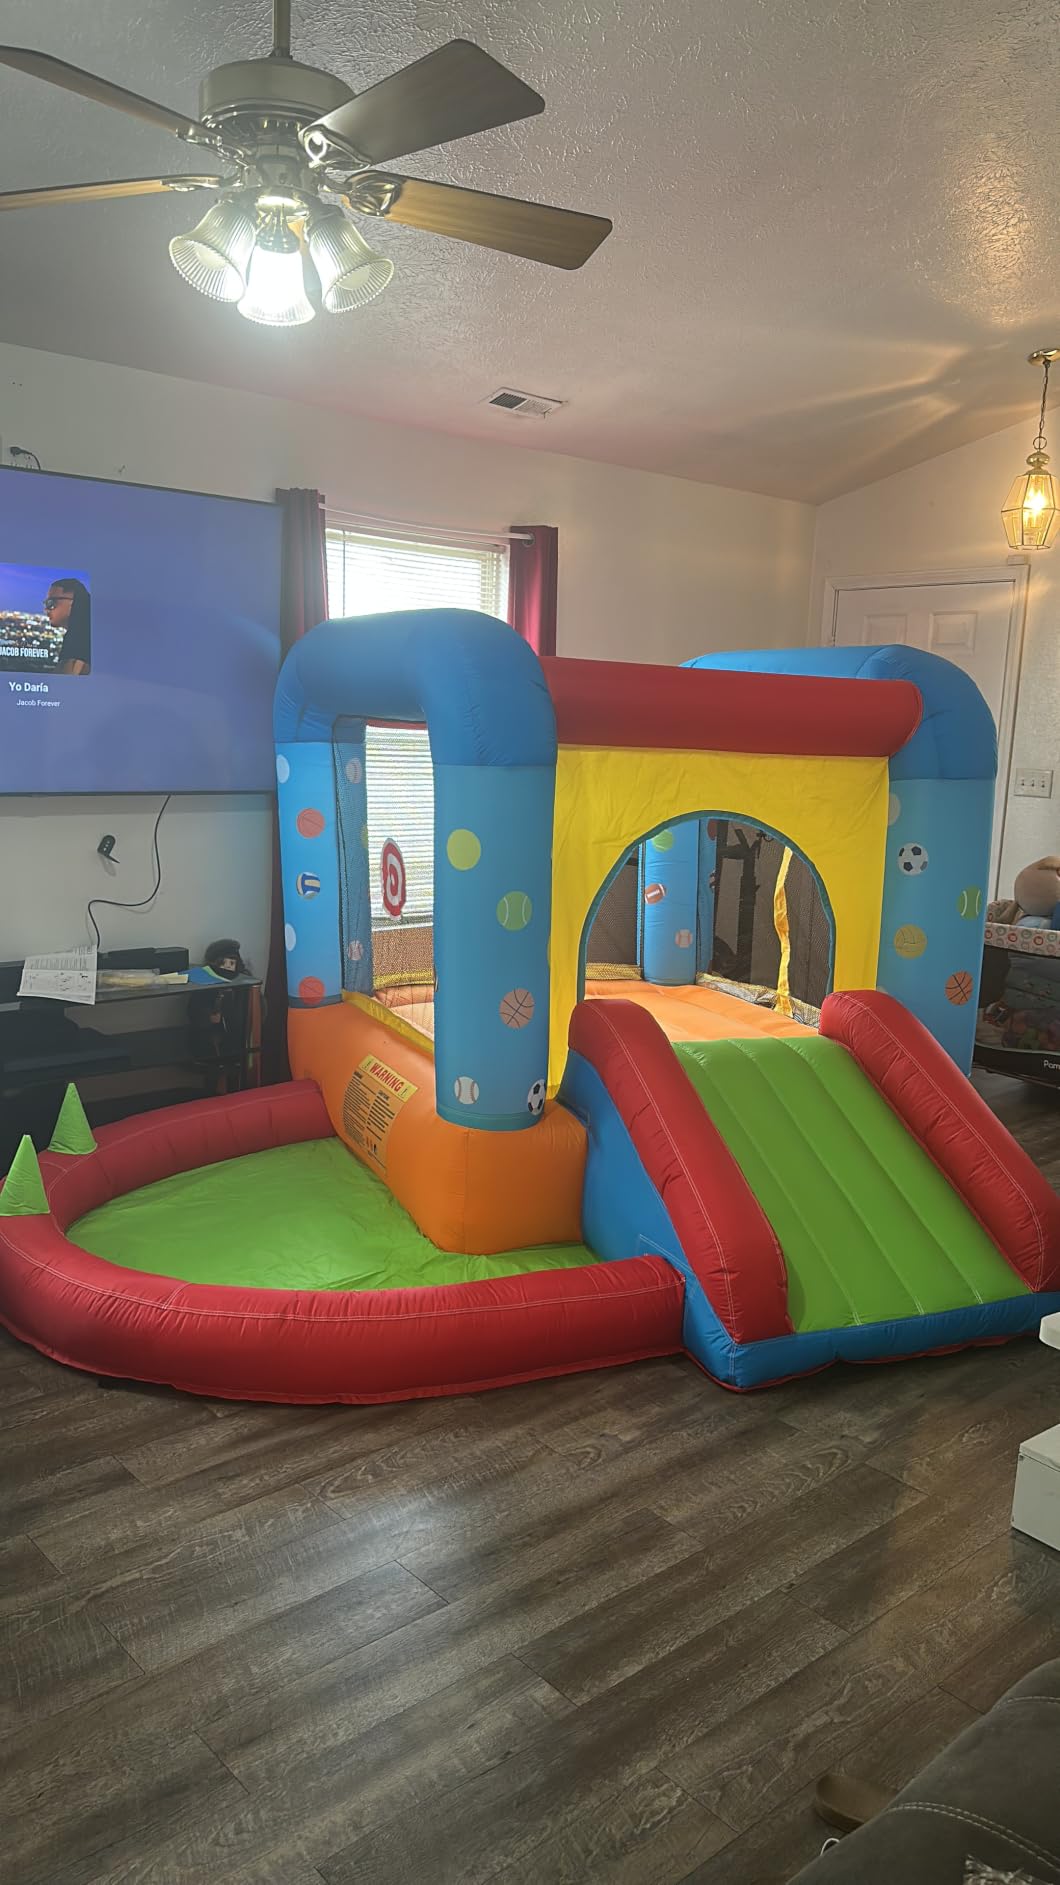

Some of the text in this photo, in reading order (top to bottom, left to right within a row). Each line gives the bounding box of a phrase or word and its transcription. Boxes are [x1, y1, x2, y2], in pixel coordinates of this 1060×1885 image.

[20, 647, 49, 658] FOREVER
[8, 681, 49, 693] Yo Daría
[369, 1062, 405, 1092] WARNING
